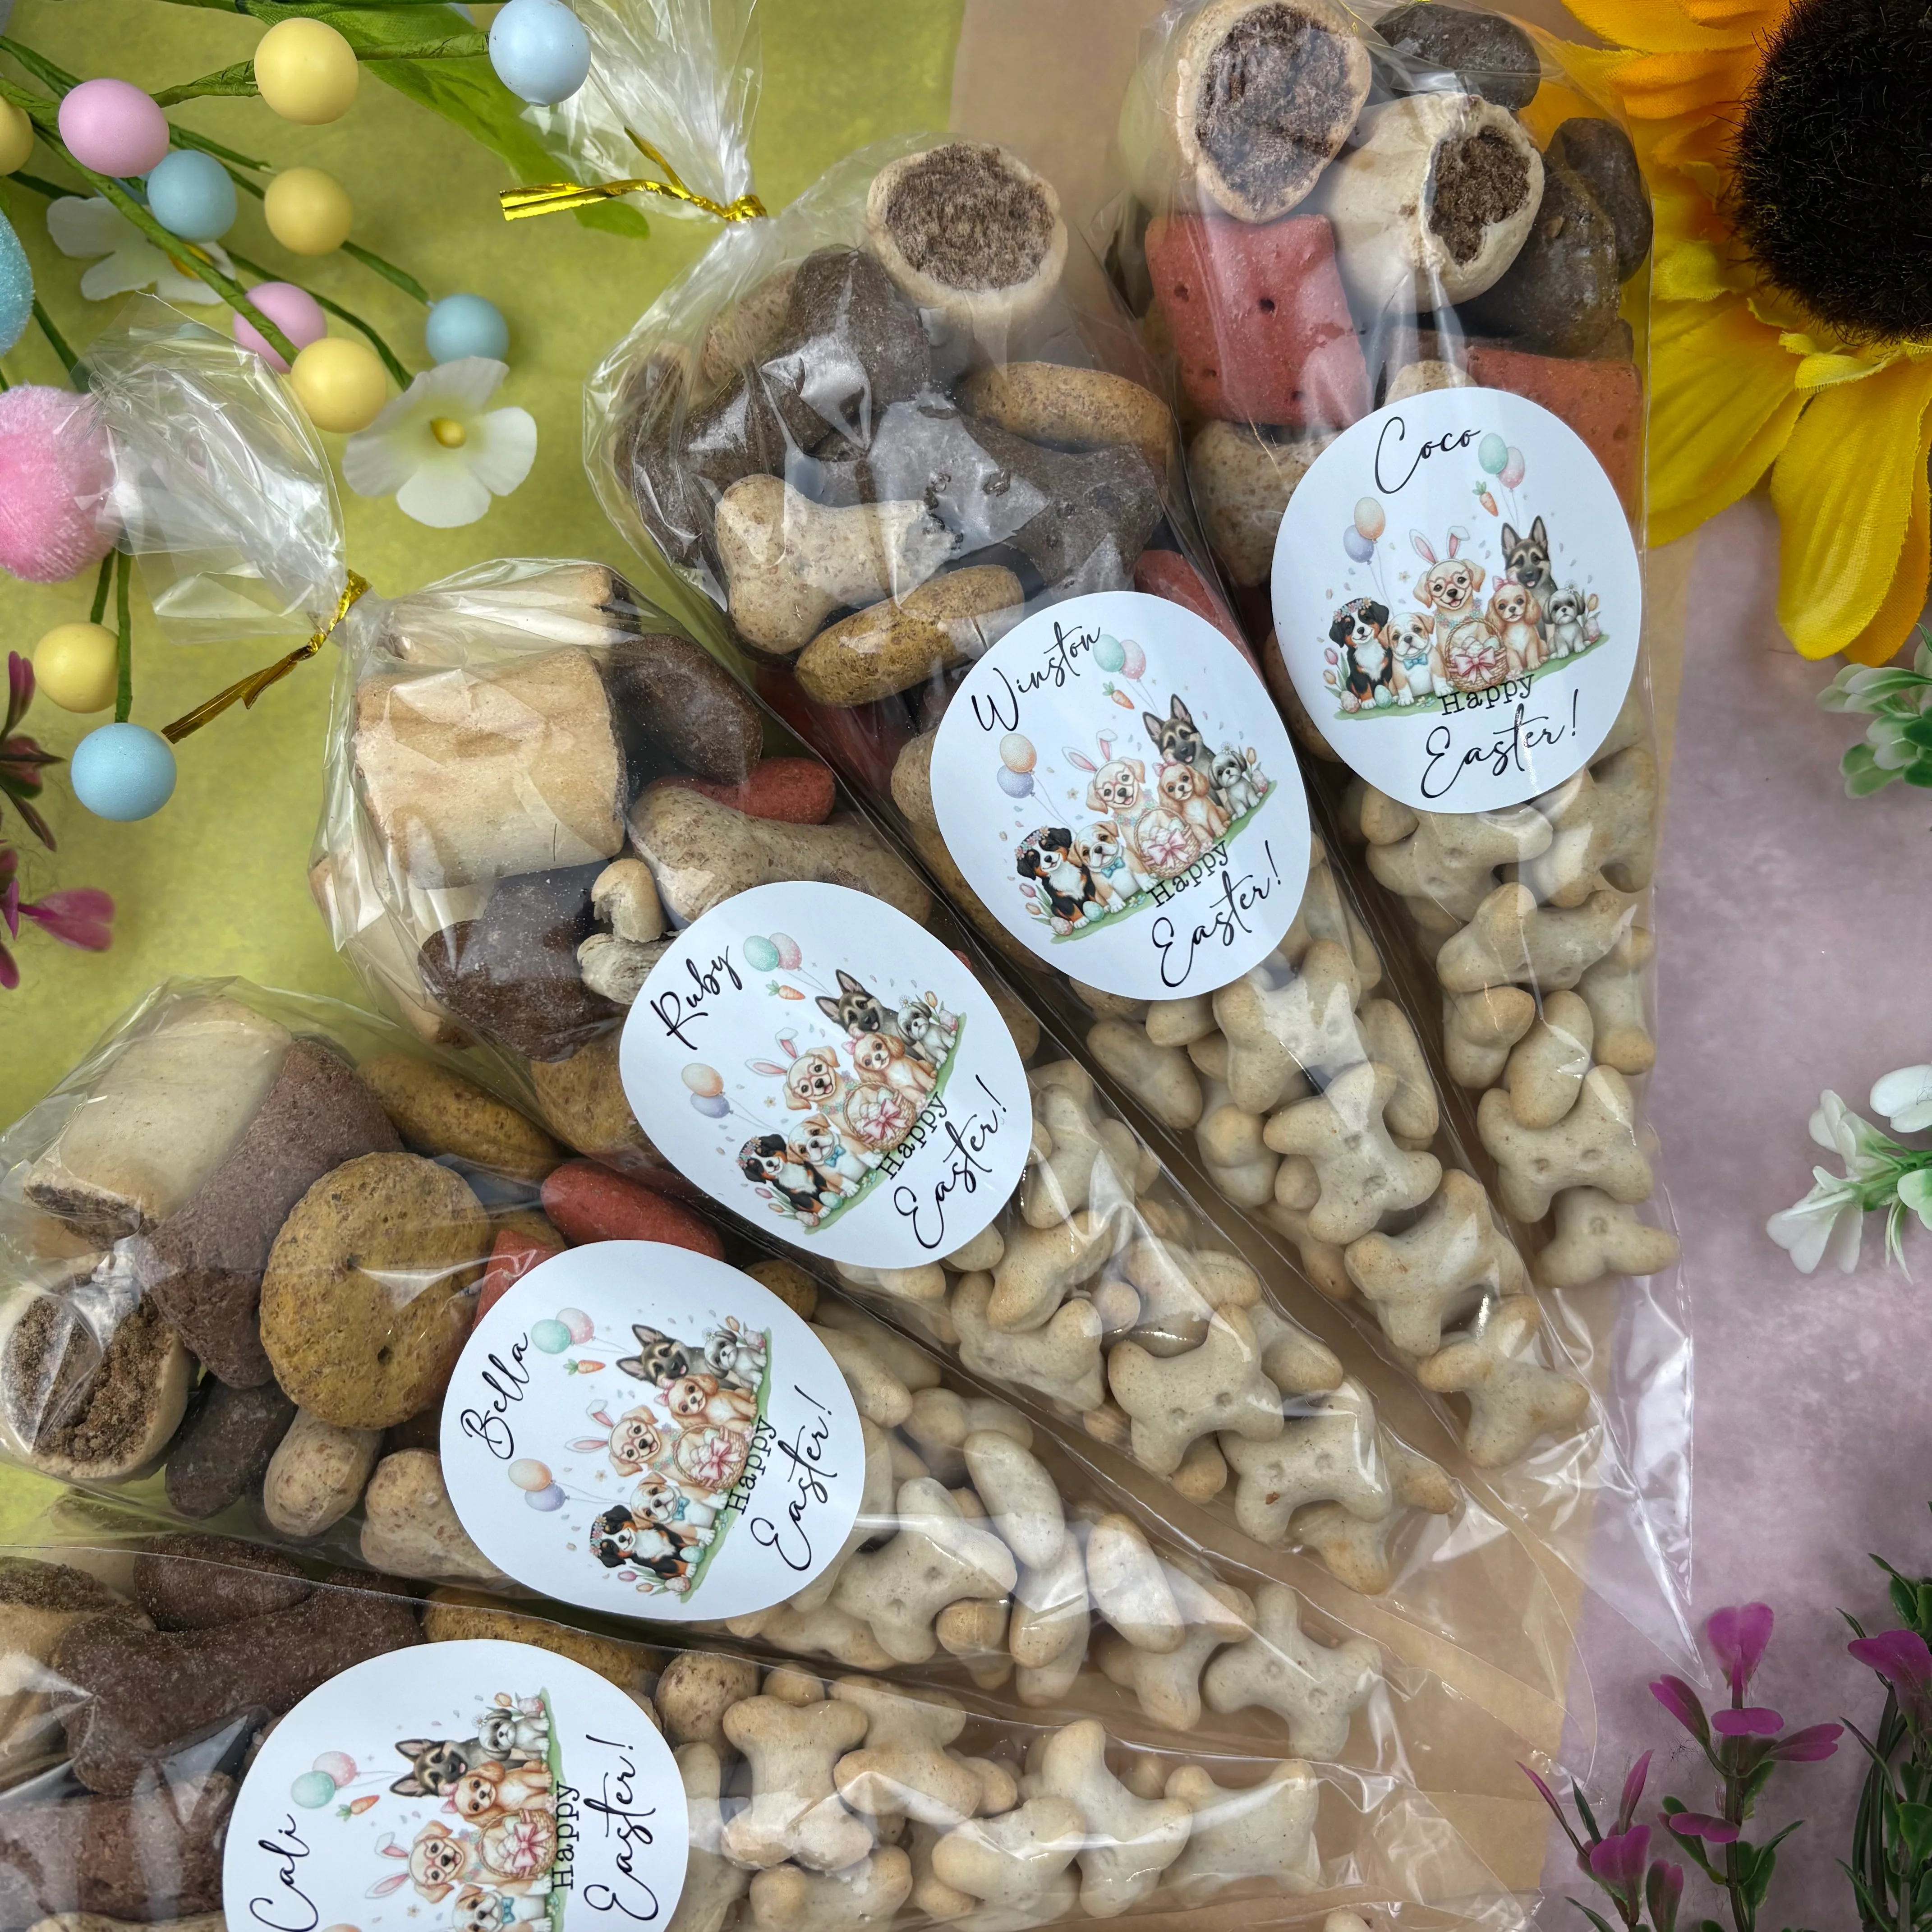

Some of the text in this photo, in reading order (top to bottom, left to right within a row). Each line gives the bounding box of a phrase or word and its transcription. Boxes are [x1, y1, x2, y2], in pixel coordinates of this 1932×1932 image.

[1375, 417, 1481, 494] Coco
[971, 621, 1101, 731] Winston
[1437, 673, 1535, 716] Happy
[1420, 689, 1579, 799] Easter!
[1146, 837, 1230, 908] Happy
[1151, 839, 1282, 987] Easter!
[650, 945, 743, 1050] Ruby
[875, 1090, 948, 1178] Happy
[893, 1074, 1007, 1249] Easter!
[460, 1331, 530, 1460] Bella
[724, 1414, 777, 1515] Happy
[750, 1385, 838, 1571] Easter!
[249, 1813, 319, 1932] Cali
[551, 1780, 580, 1891] Happy
[583, 1734, 659, 1921] Easter!
